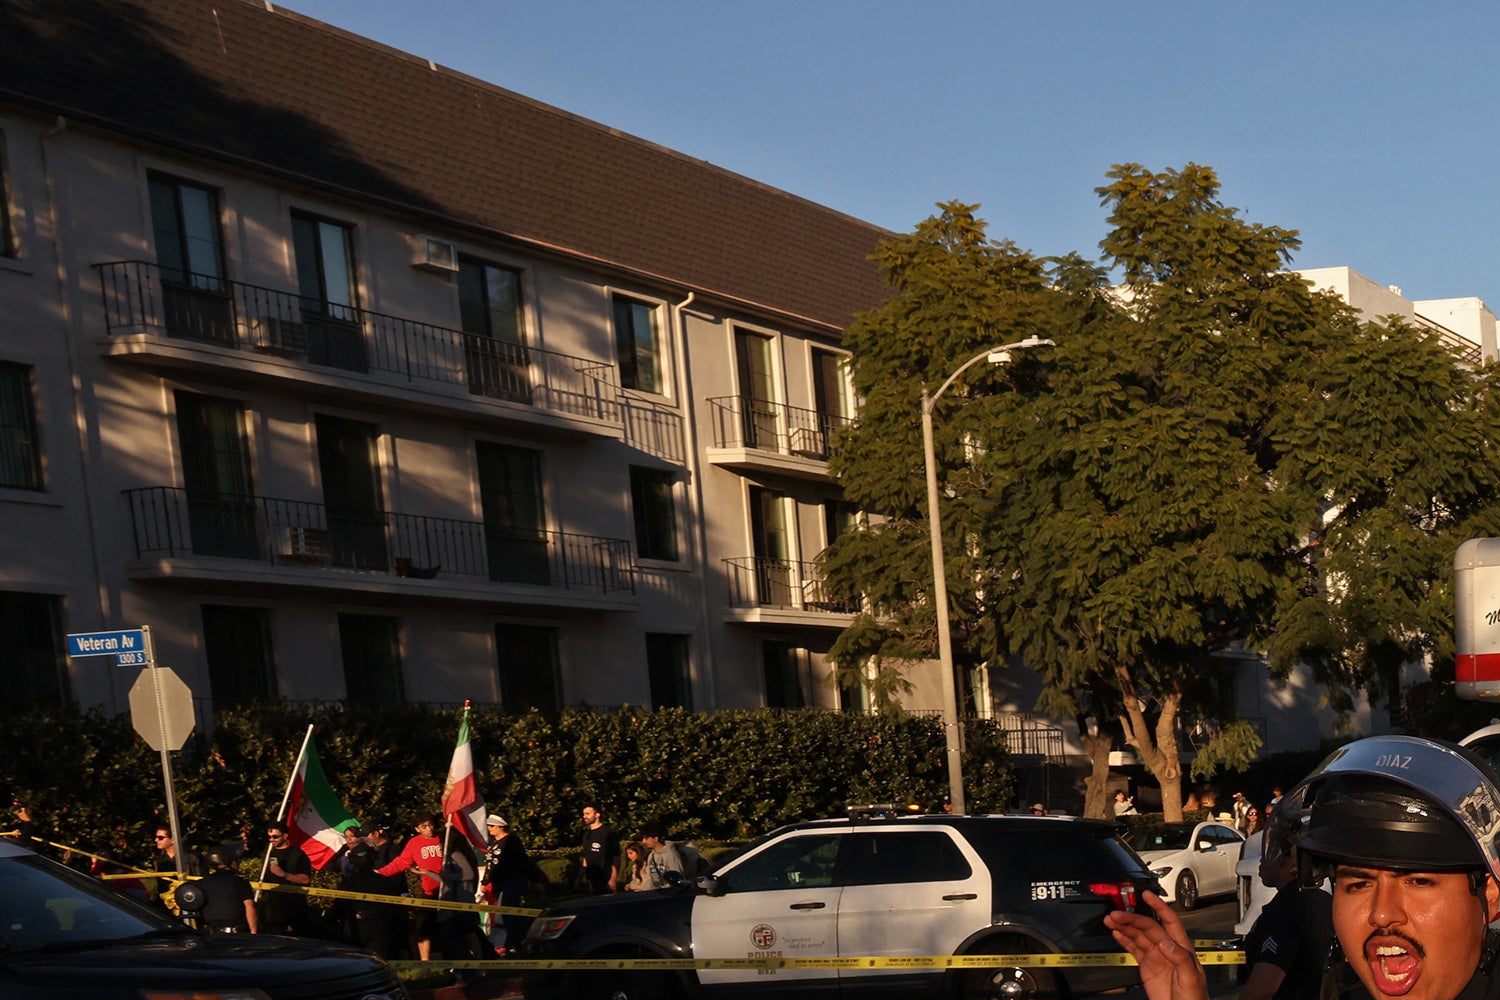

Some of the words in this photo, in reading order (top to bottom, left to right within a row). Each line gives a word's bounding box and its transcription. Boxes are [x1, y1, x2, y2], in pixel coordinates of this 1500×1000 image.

[76, 637, 118, 651] Veteran
[121, 634, 134, 648] Av
[119, 654, 136, 663] 1300
[137, 653, 143, 662] S
[1375, 754, 1413, 769] DIAZ
[747, 950, 783, 959] POLICE
